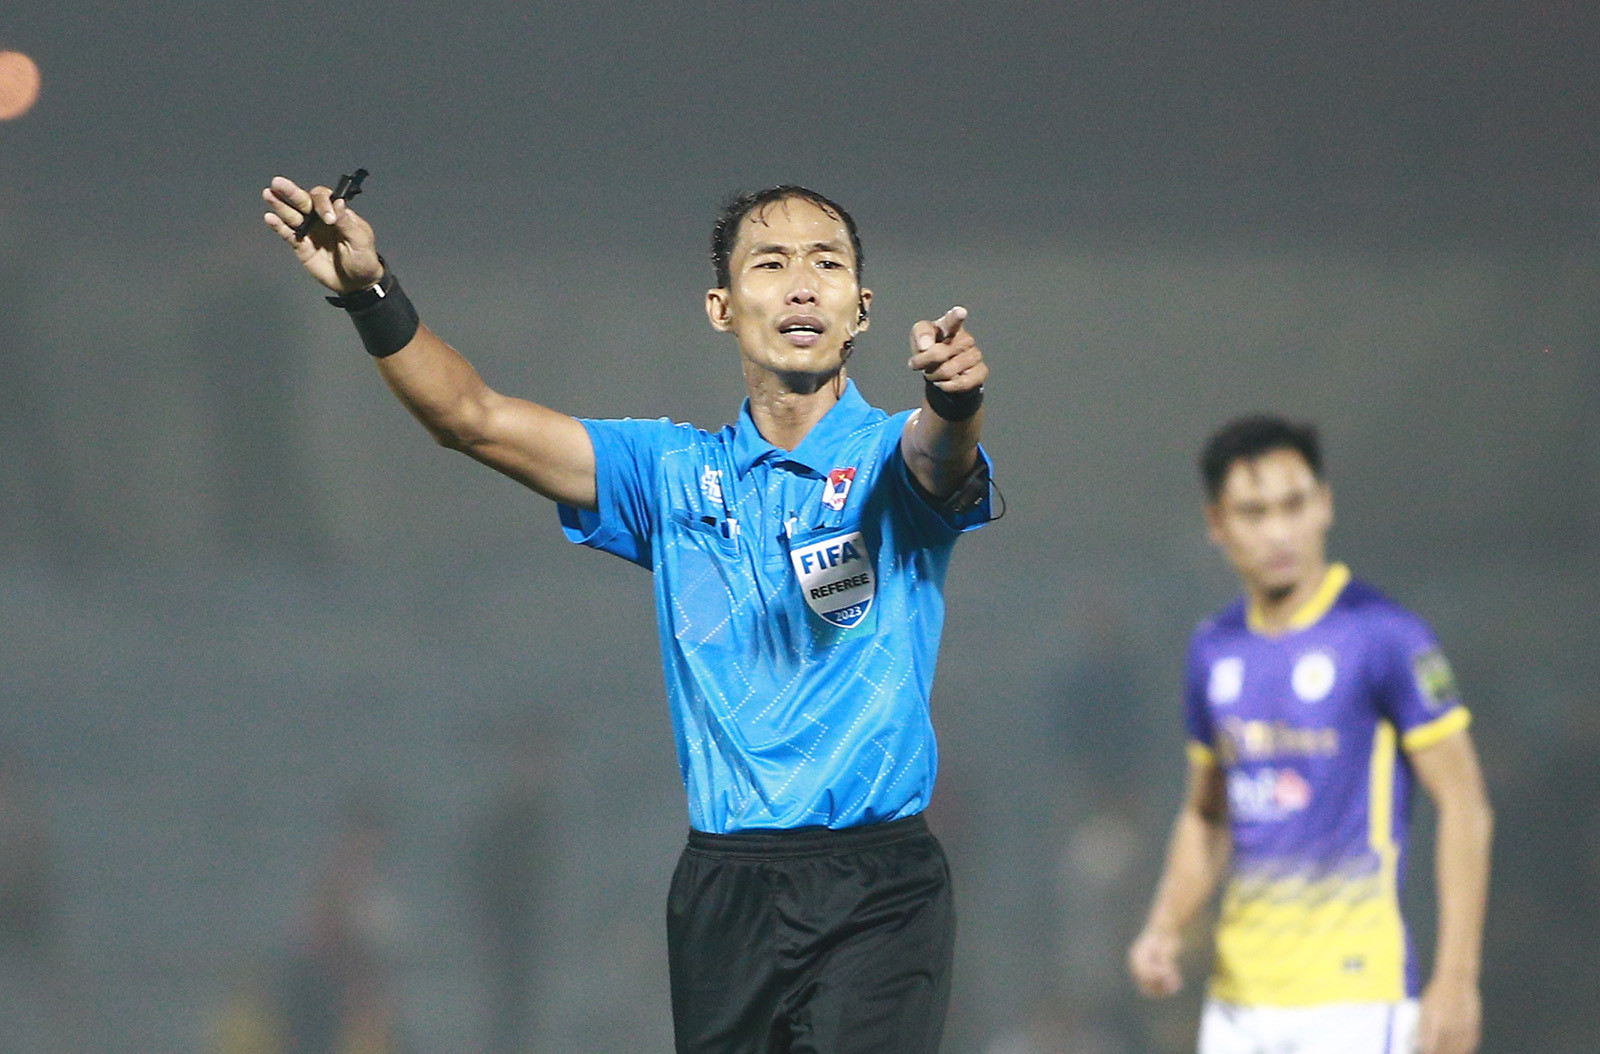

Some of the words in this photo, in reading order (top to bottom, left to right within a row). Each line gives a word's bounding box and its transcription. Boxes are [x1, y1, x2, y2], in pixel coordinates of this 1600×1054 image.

[800, 541, 861, 575] FIFA
[809, 573, 870, 600] REFEREE
[836, 606, 862, 622] 2023
